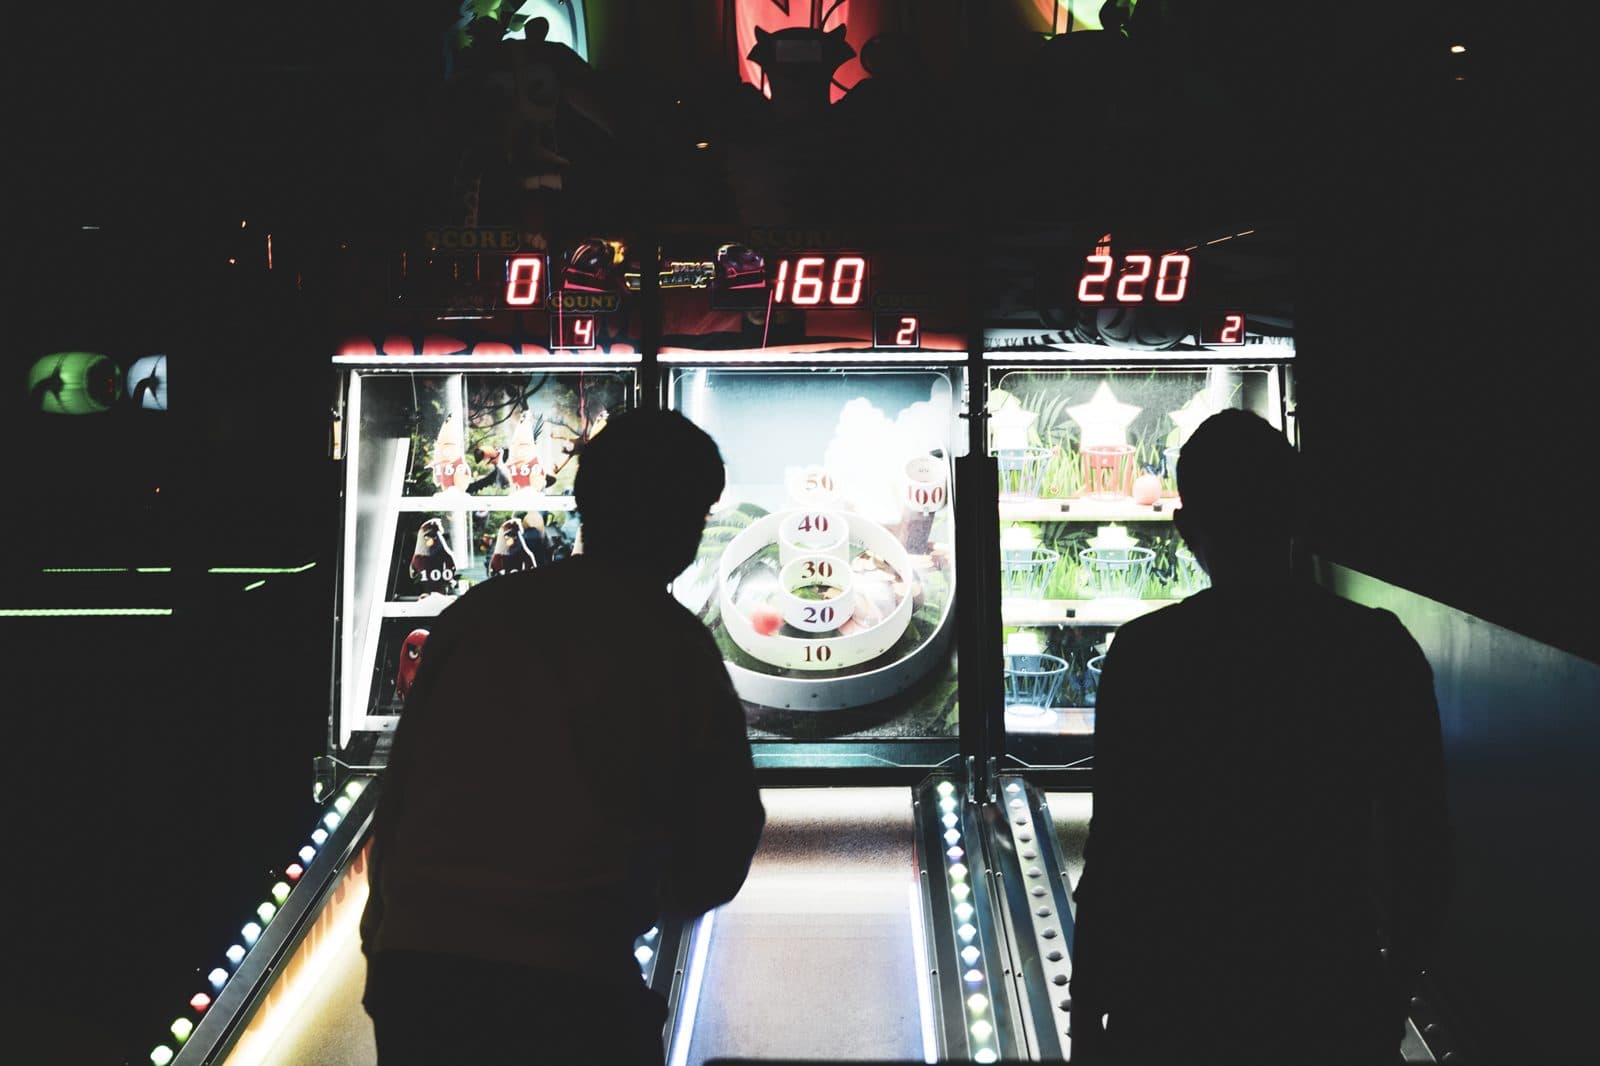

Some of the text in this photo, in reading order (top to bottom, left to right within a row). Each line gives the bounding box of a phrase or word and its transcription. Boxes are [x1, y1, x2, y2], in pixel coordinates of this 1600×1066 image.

[424, 231, 516, 249] SCORE
[506, 257, 542, 306] 0
[773, 256, 867, 306] 160
[1077, 254, 1191, 303] 220
[551, 296, 616, 309] COUNT
[573, 319, 594, 345] 4
[896, 317, 917, 345] 2
[1221, 315, 1243, 343] 2
[805, 473, 834, 492] 50
[798, 515, 829, 532] 40
[420, 569, 454, 581] 100
[801, 561, 833, 578] 30
[803, 606, 834, 623] 20
[804, 645, 832, 662] 10
